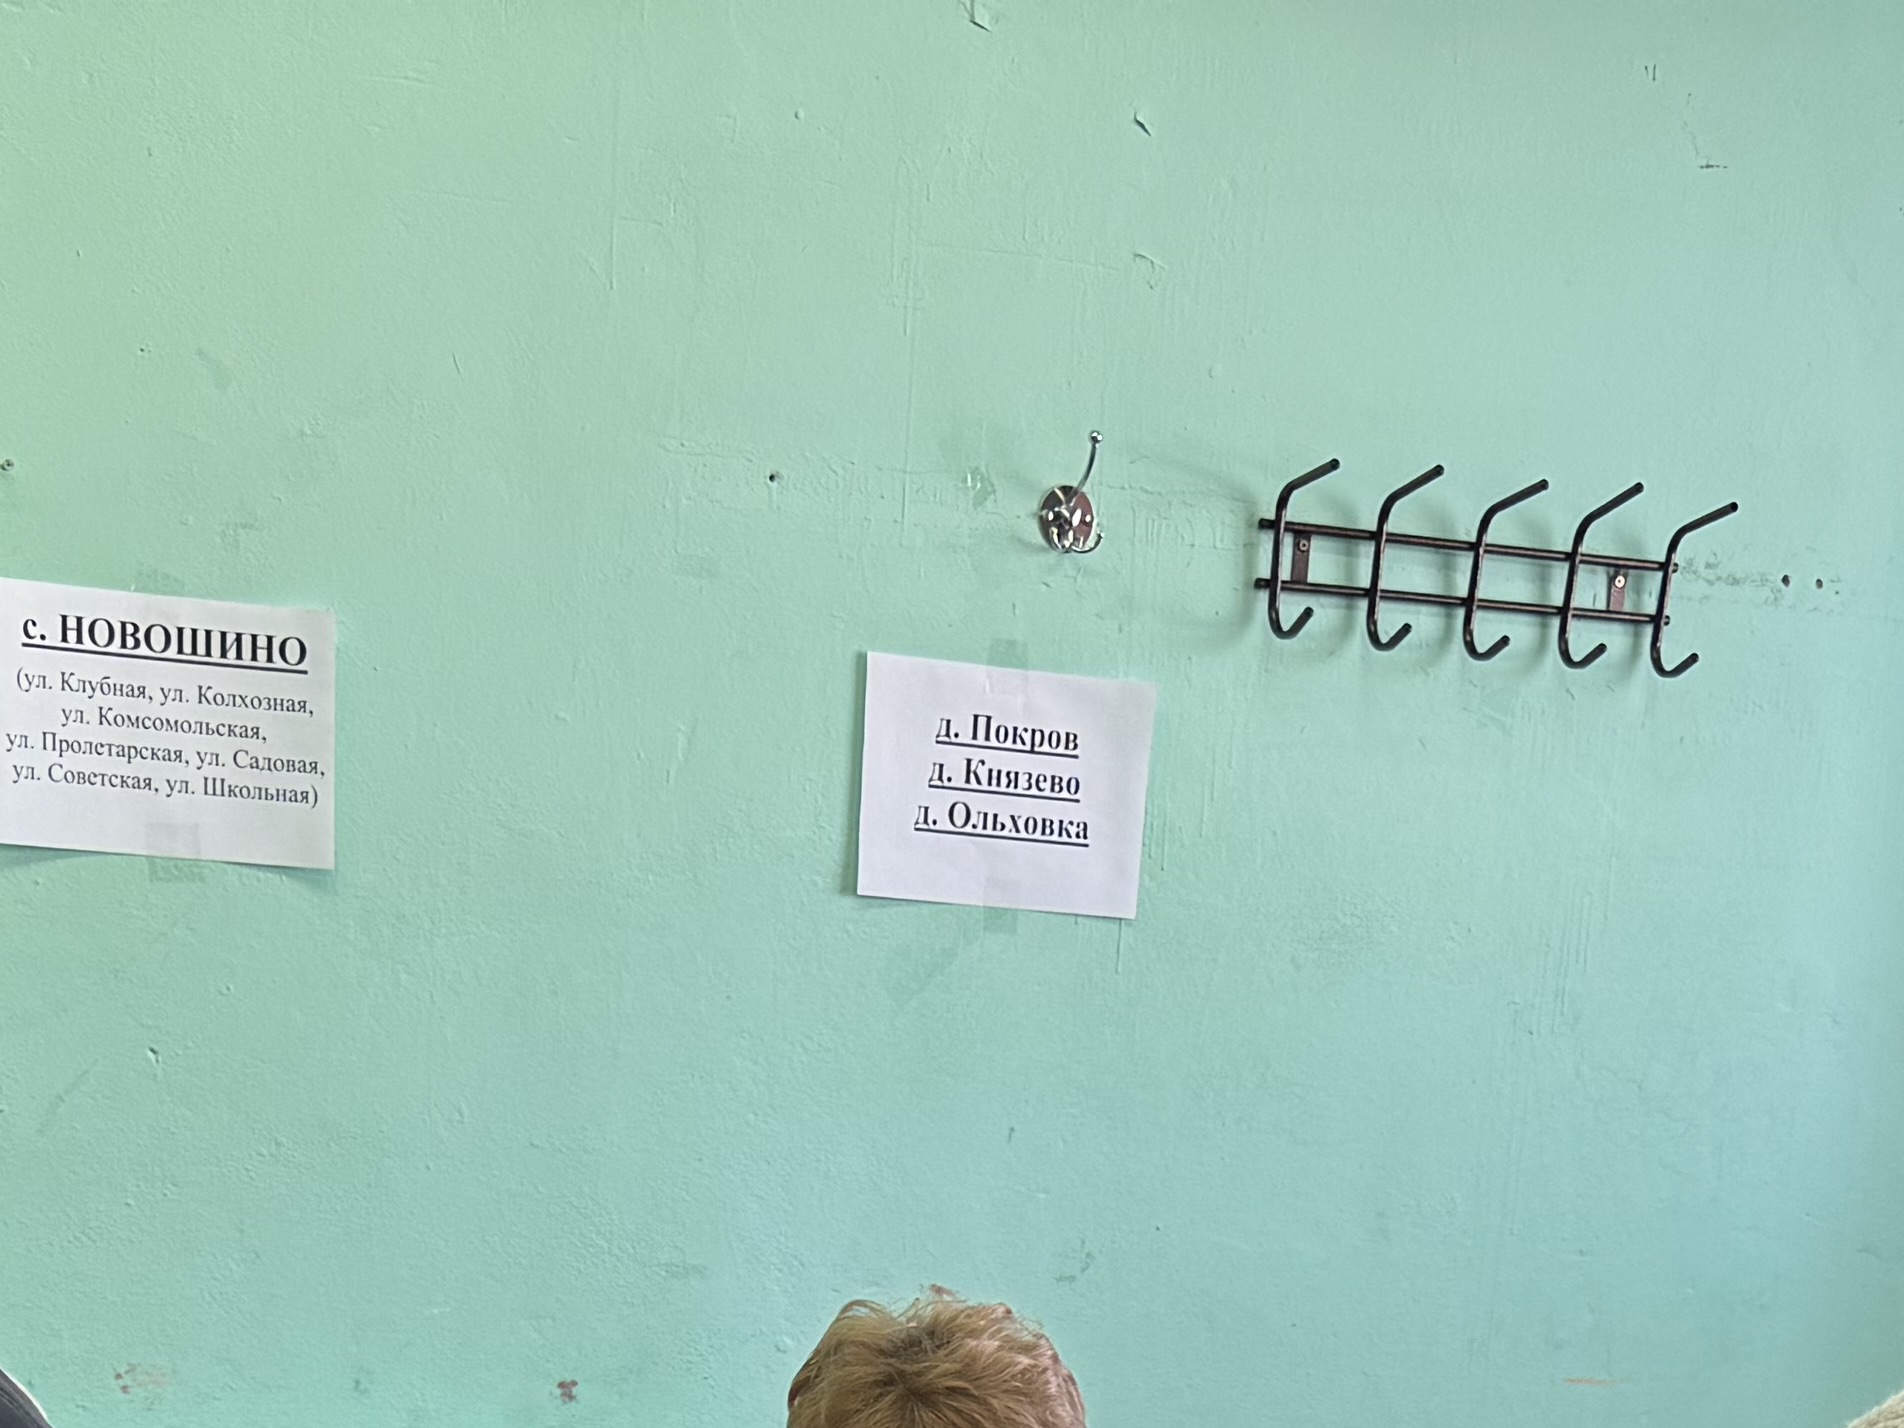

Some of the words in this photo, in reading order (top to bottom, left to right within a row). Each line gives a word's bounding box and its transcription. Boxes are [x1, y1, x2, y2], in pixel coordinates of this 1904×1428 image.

[22, 617, 47, 641] с.
[59, 613, 308, 667] НОВОШИНО
[16, 667, 53, 693] (ул.
[60, 672, 153, 703] Клубная,
[159, 686, 190, 707] ул.
[197, 685, 314, 717] Колхозная,
[61, 707, 90, 727] ул.
[98, 706, 267, 742] Комсомольская,
[936, 717, 959, 742] д.
[971, 714, 1079, 751] Покров
[5, 732, 35, 752] ул.
[42, 732, 190, 766] Пролетарская,
[196, 750, 226, 770] ул.
[233, 749, 325, 778] Садовая,
[12, 763, 41, 784] ул.
[48, 763, 159, 794] Советская,
[166, 778, 195, 799] ул.
[203, 776, 319, 809] Школьная)
[928, 762, 952, 786] д.
[964, 758, 1080, 796] Князево
[914, 805, 937, 828] д.
[948, 801, 1088, 840] Ольховка
